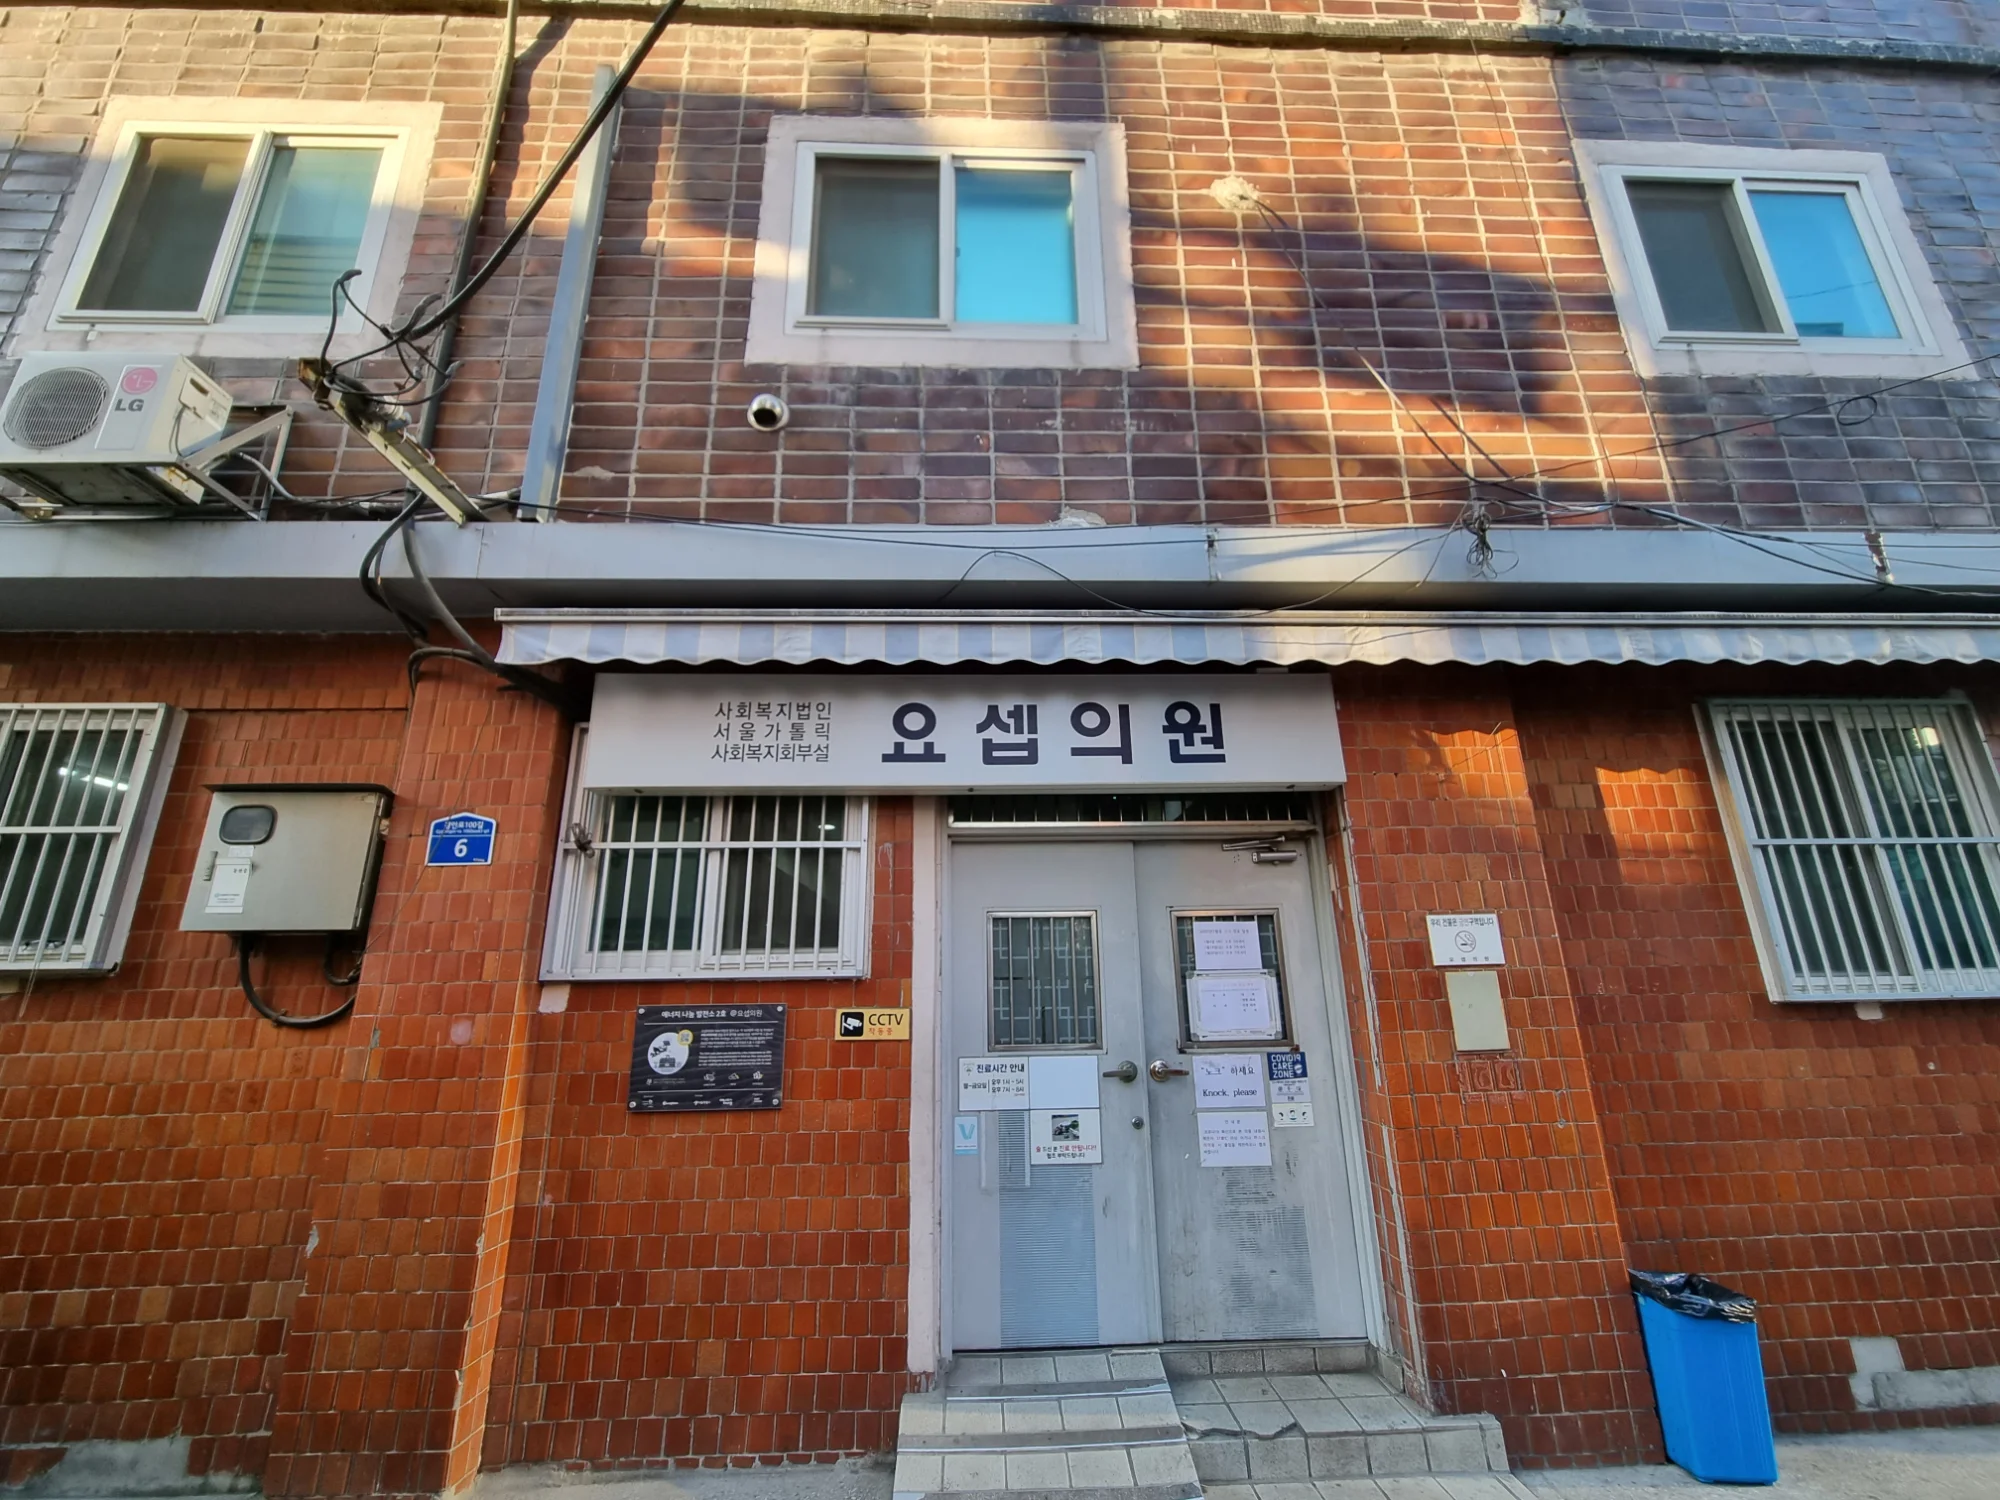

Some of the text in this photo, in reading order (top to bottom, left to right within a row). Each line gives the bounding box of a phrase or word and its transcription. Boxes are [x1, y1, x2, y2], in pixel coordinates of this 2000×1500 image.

[114, 398, 144, 412] LG
[714, 701, 832, 720] 사회복지법인
[713, 722, 830, 741] 서울가톨릭
[881, 701, 1226, 765] 요셉의원
[710, 743, 829, 762] 사회복지회부설
[454, 838, 468, 857] 6
[868, 1014, 904, 1026] CCTV
[977, 1063, 1025, 1073] 진료시간 안내
[1272, 1062, 1294, 1070] CARE
[1273, 1070, 1294, 1078] ZONE
[1233, 1089, 1257, 1097] please
